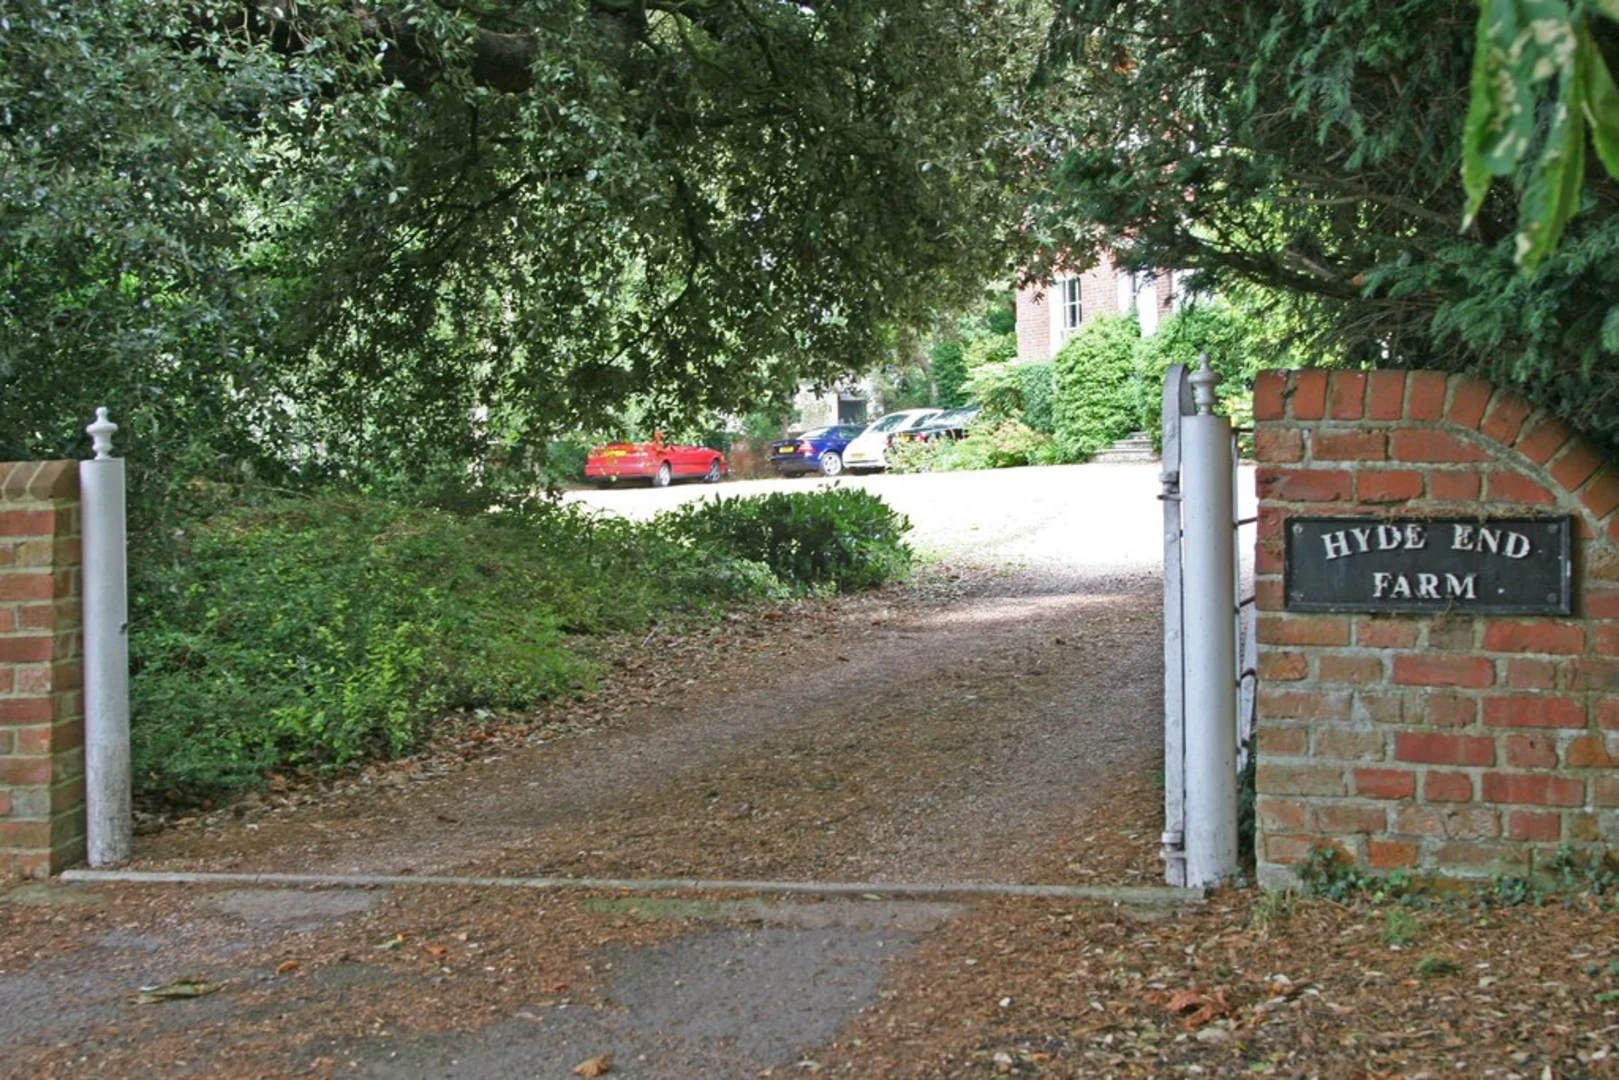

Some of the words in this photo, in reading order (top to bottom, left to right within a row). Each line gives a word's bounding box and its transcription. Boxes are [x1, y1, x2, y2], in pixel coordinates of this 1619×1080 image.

[1321, 523, 1428, 560] HYDE
[1451, 523, 1531, 560] END
[1372, 571, 1478, 599] FARM
